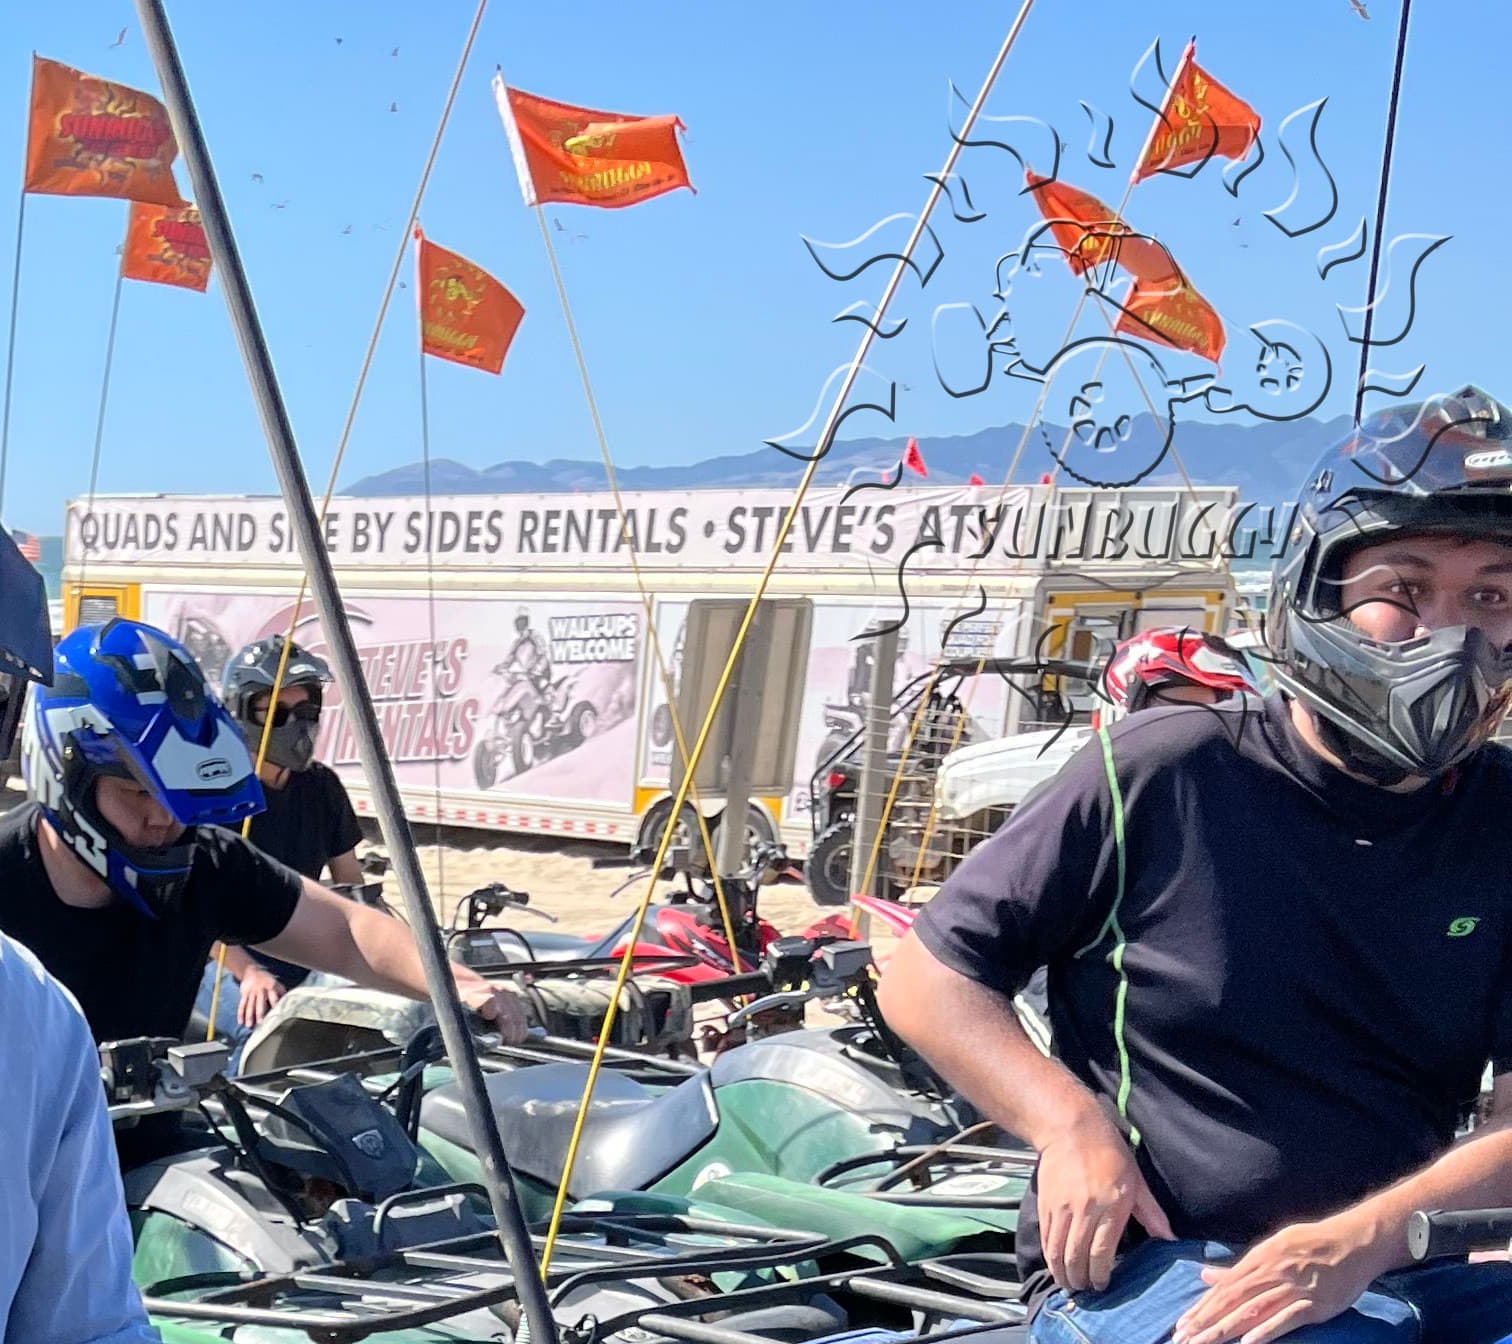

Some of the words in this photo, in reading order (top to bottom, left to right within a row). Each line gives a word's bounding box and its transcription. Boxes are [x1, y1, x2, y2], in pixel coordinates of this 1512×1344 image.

[80, 511, 178, 554] QUADS
[189, 512, 256, 552] AND
[353, 510, 394, 553] BY
[402, 509, 504, 554] SIDES
[517, 507, 688, 554] RENTALS
[723, 505, 896, 554] STEVE'S
[550, 638, 635, 664] WELCOME
